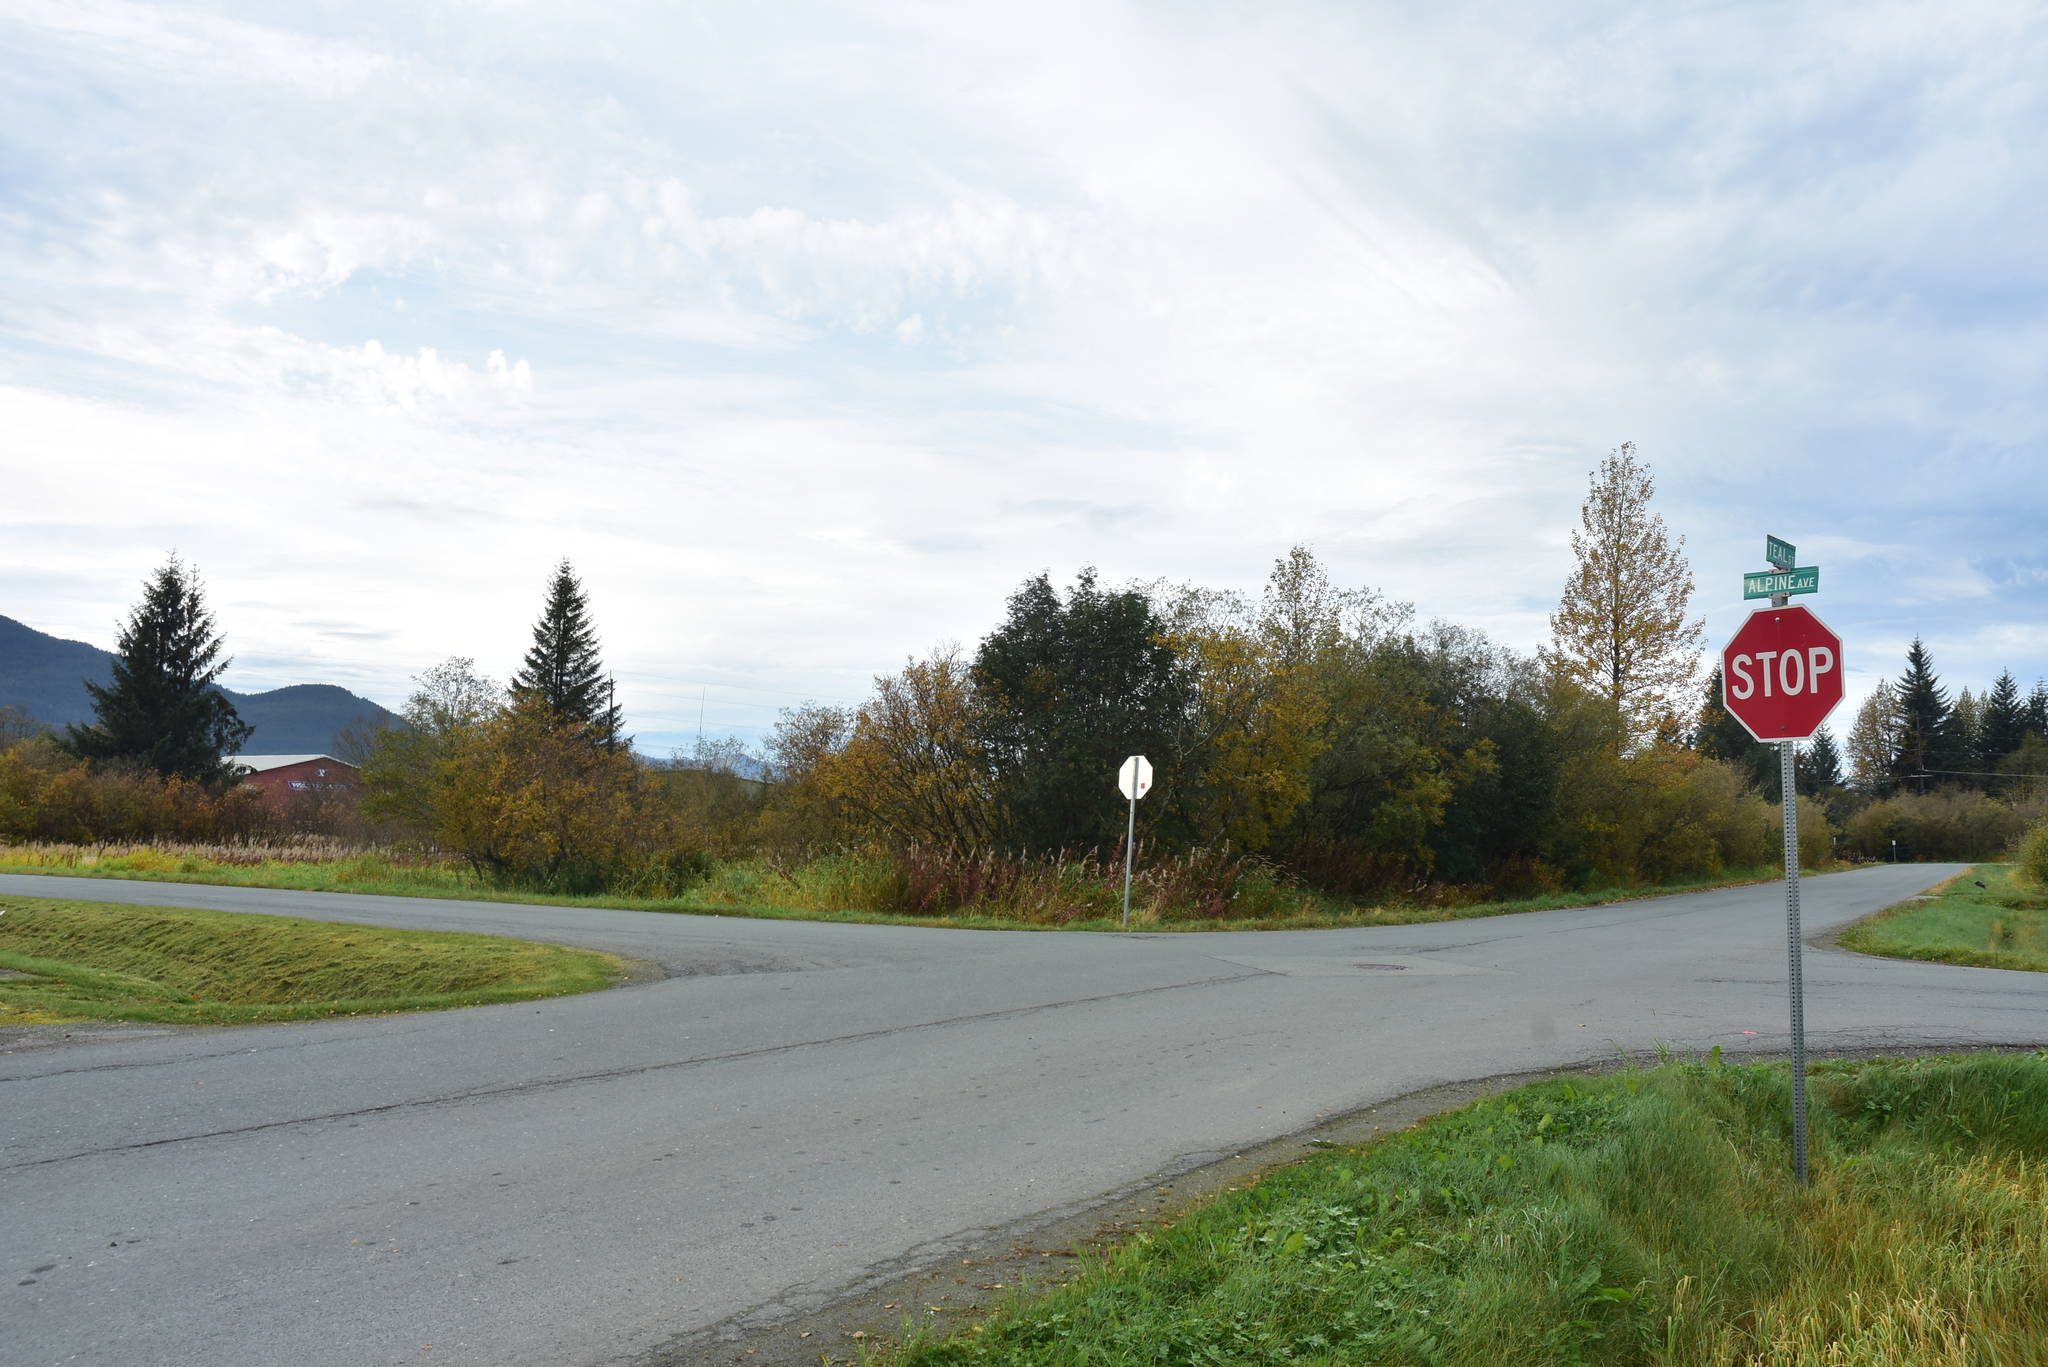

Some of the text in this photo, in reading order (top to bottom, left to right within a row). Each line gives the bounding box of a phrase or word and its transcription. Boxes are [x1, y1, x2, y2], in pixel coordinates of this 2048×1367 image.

[1769, 542, 1788, 562] TEAL
[1748, 575, 1815, 593] ALPINE AVE
[1731, 646, 1834, 700] STOP
